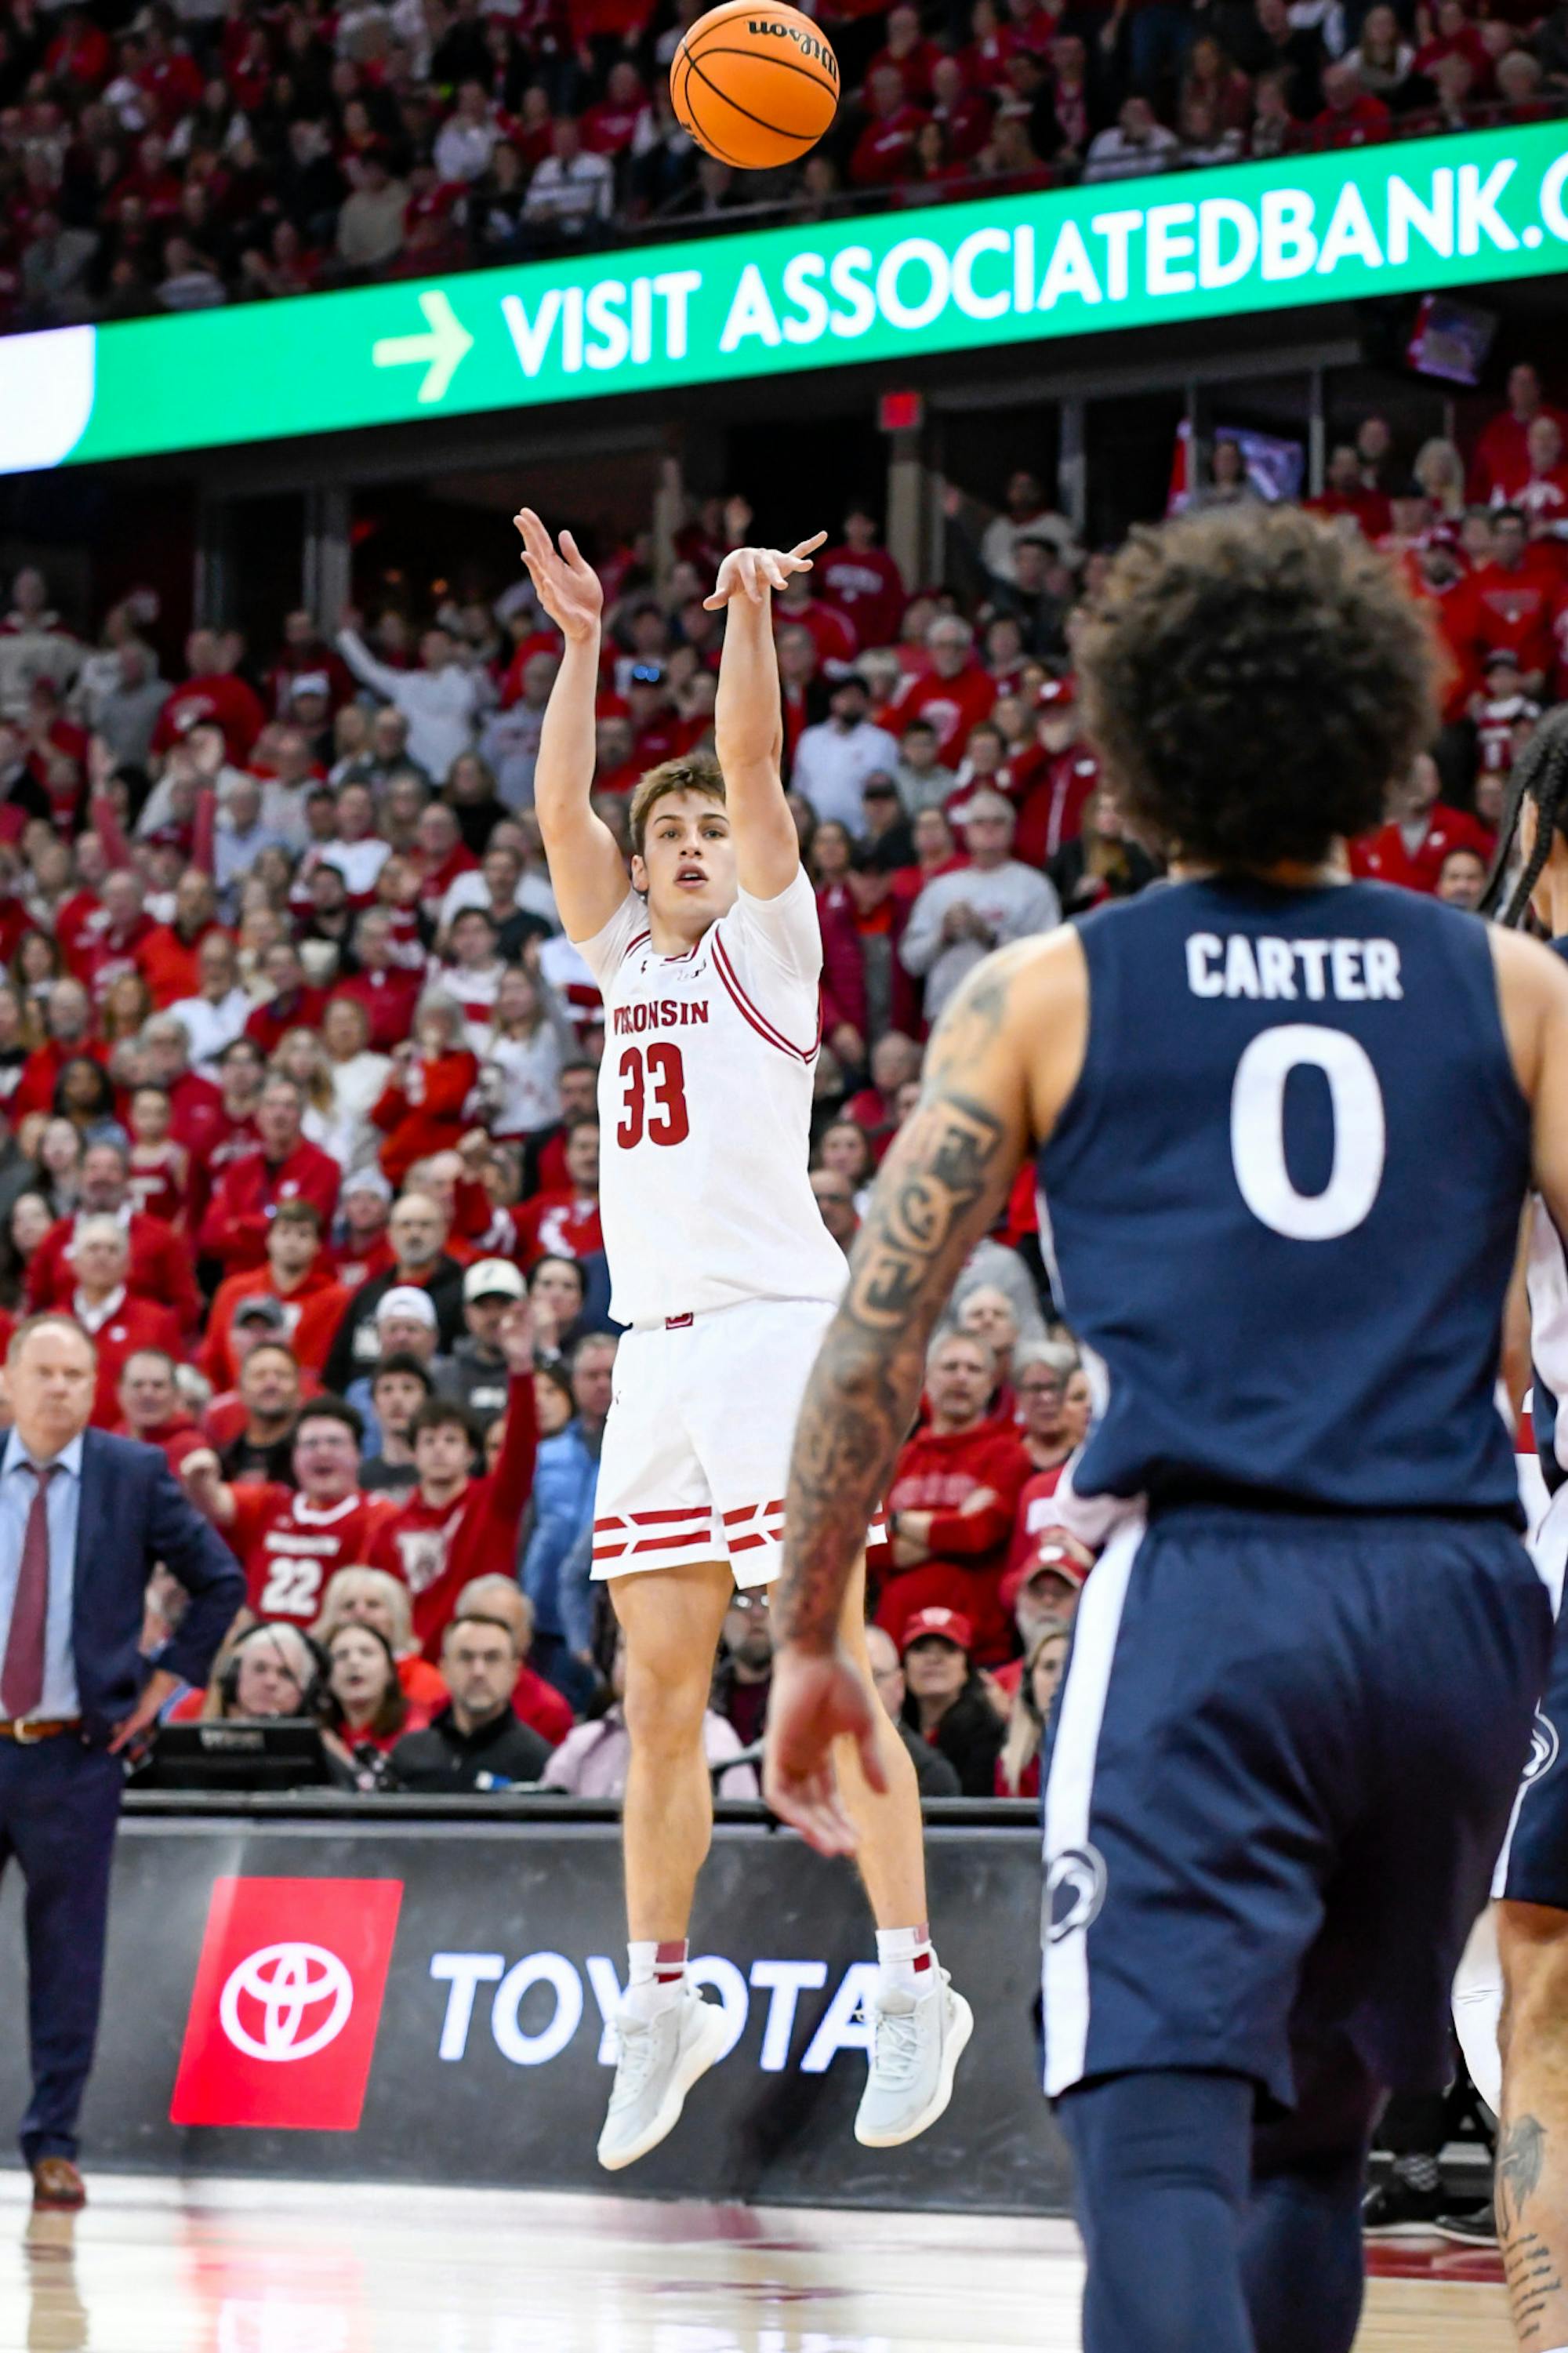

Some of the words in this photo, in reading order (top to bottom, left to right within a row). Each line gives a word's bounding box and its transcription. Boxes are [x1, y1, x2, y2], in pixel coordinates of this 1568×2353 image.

[502, 271, 702, 376] VISIT
[1186, 934, 1403, 1000] CARTER
[617, 1042, 690, 1149] 33
[1231, 1024, 1385, 1240] 0
[260, 1556, 322, 1617] 22
